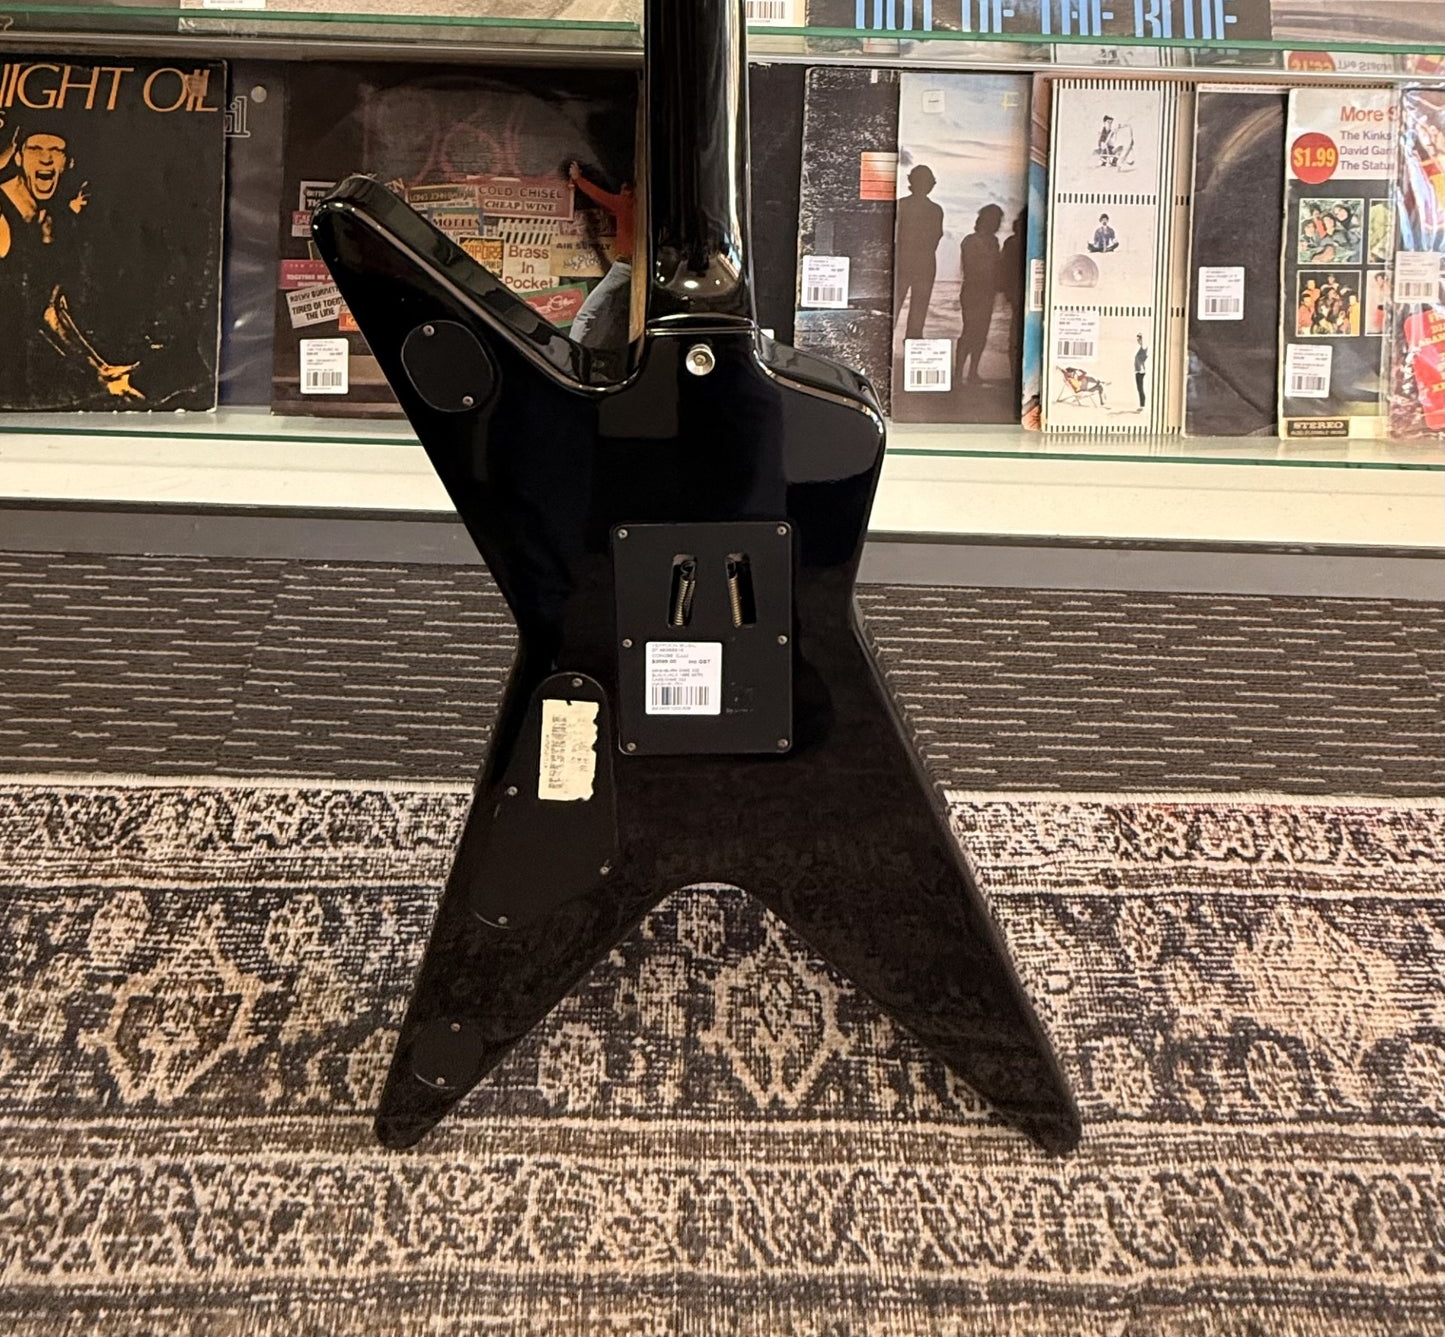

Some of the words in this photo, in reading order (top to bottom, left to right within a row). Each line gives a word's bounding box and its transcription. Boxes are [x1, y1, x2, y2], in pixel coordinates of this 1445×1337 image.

[1340, 105, 1384, 122] More
[1340, 130, 1361, 141] The
[1363, 130, 1392, 141] Kinks
[1340, 145, 1369, 156] David
[1293, 146, 1336, 168] $1.99
[1340, 160, 1360, 170] The
[478, 184, 513, 197] COLD
[519, 186, 563, 199] CHISEL
[485, 199, 522, 210] CHEAP
[526, 202, 556, 212] WINE
[508, 244, 550, 259] Brass
[556, 242, 574, 250] AIR
[521, 262, 535, 274] In
[505, 276, 553, 290] Pocket
[1293, 420, 1345, 430] STEREO
